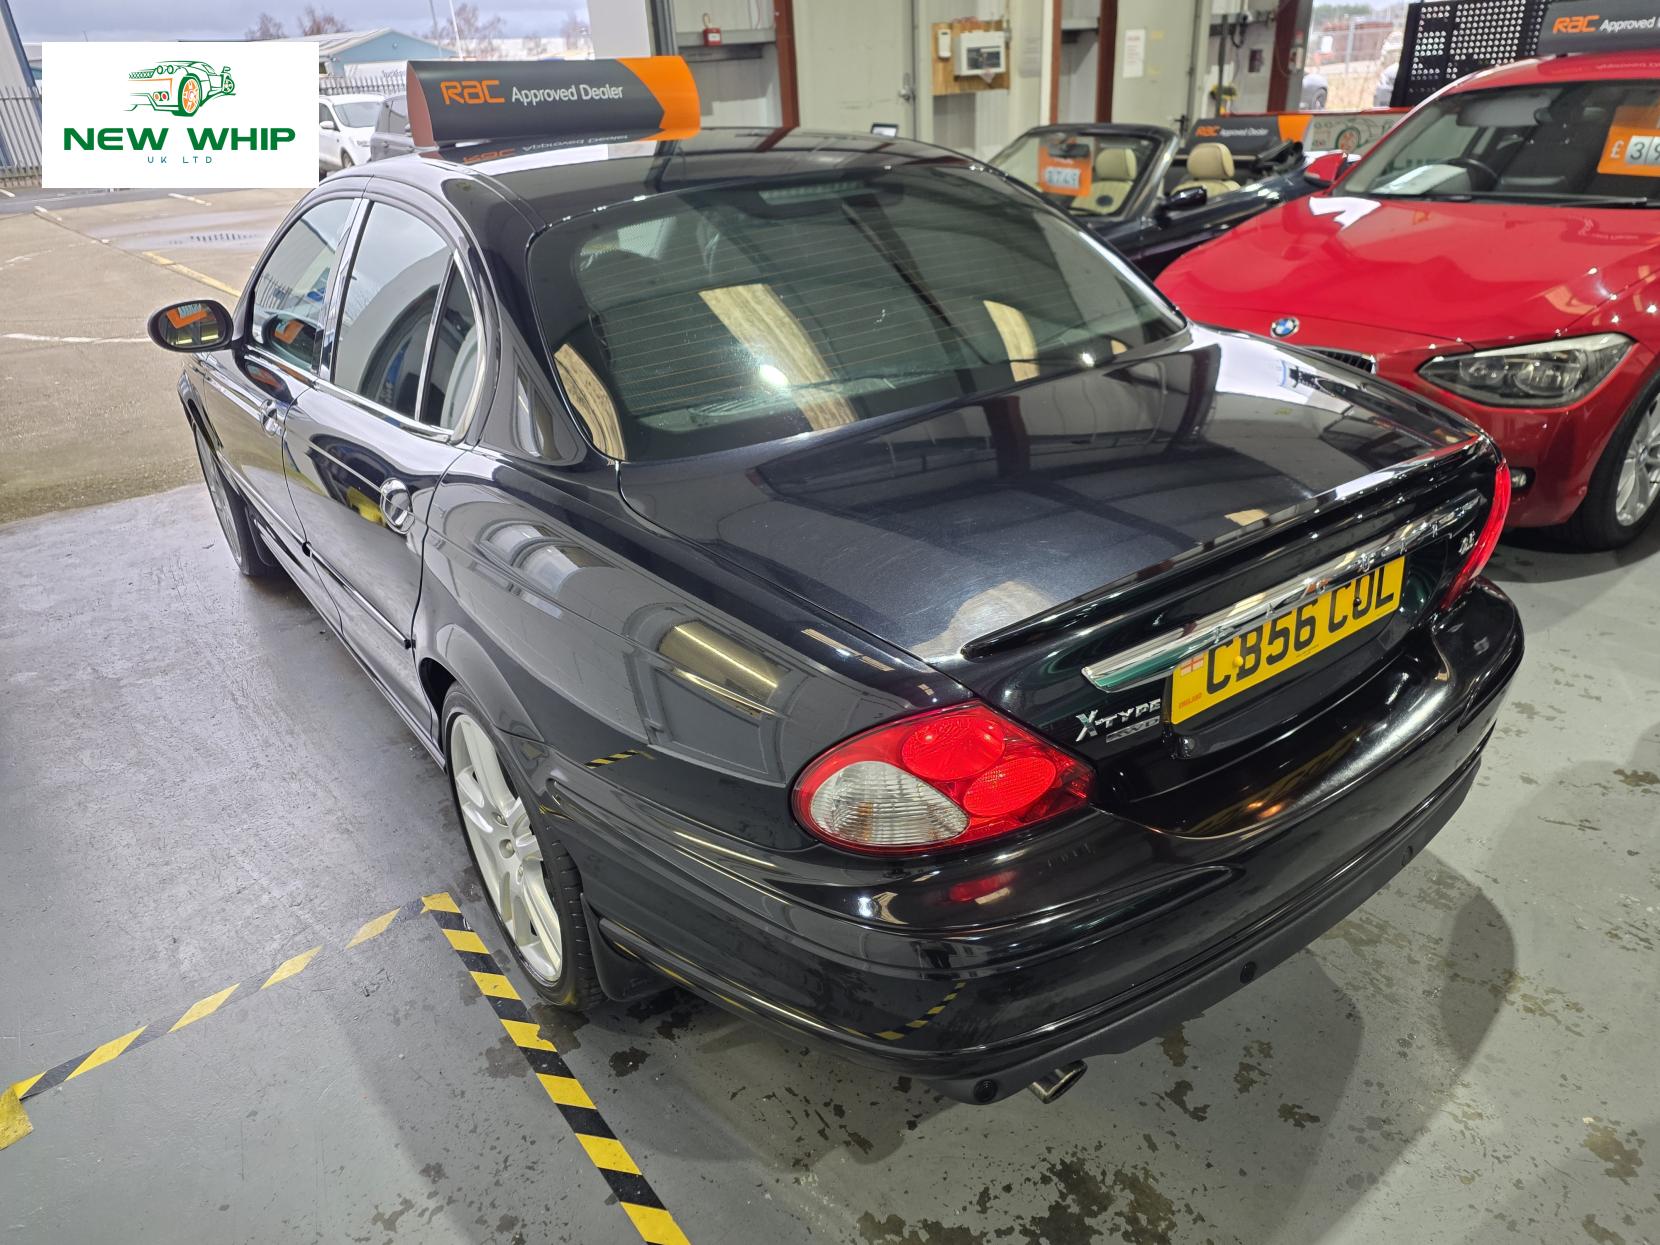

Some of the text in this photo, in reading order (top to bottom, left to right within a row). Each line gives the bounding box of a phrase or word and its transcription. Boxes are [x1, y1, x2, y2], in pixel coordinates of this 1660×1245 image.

[1600, 16, 1656, 33] Approved
[512, 85, 578, 105] Approved
[580, 84, 624, 100] Dealer
[1206, 600, 1320, 695] CB56
